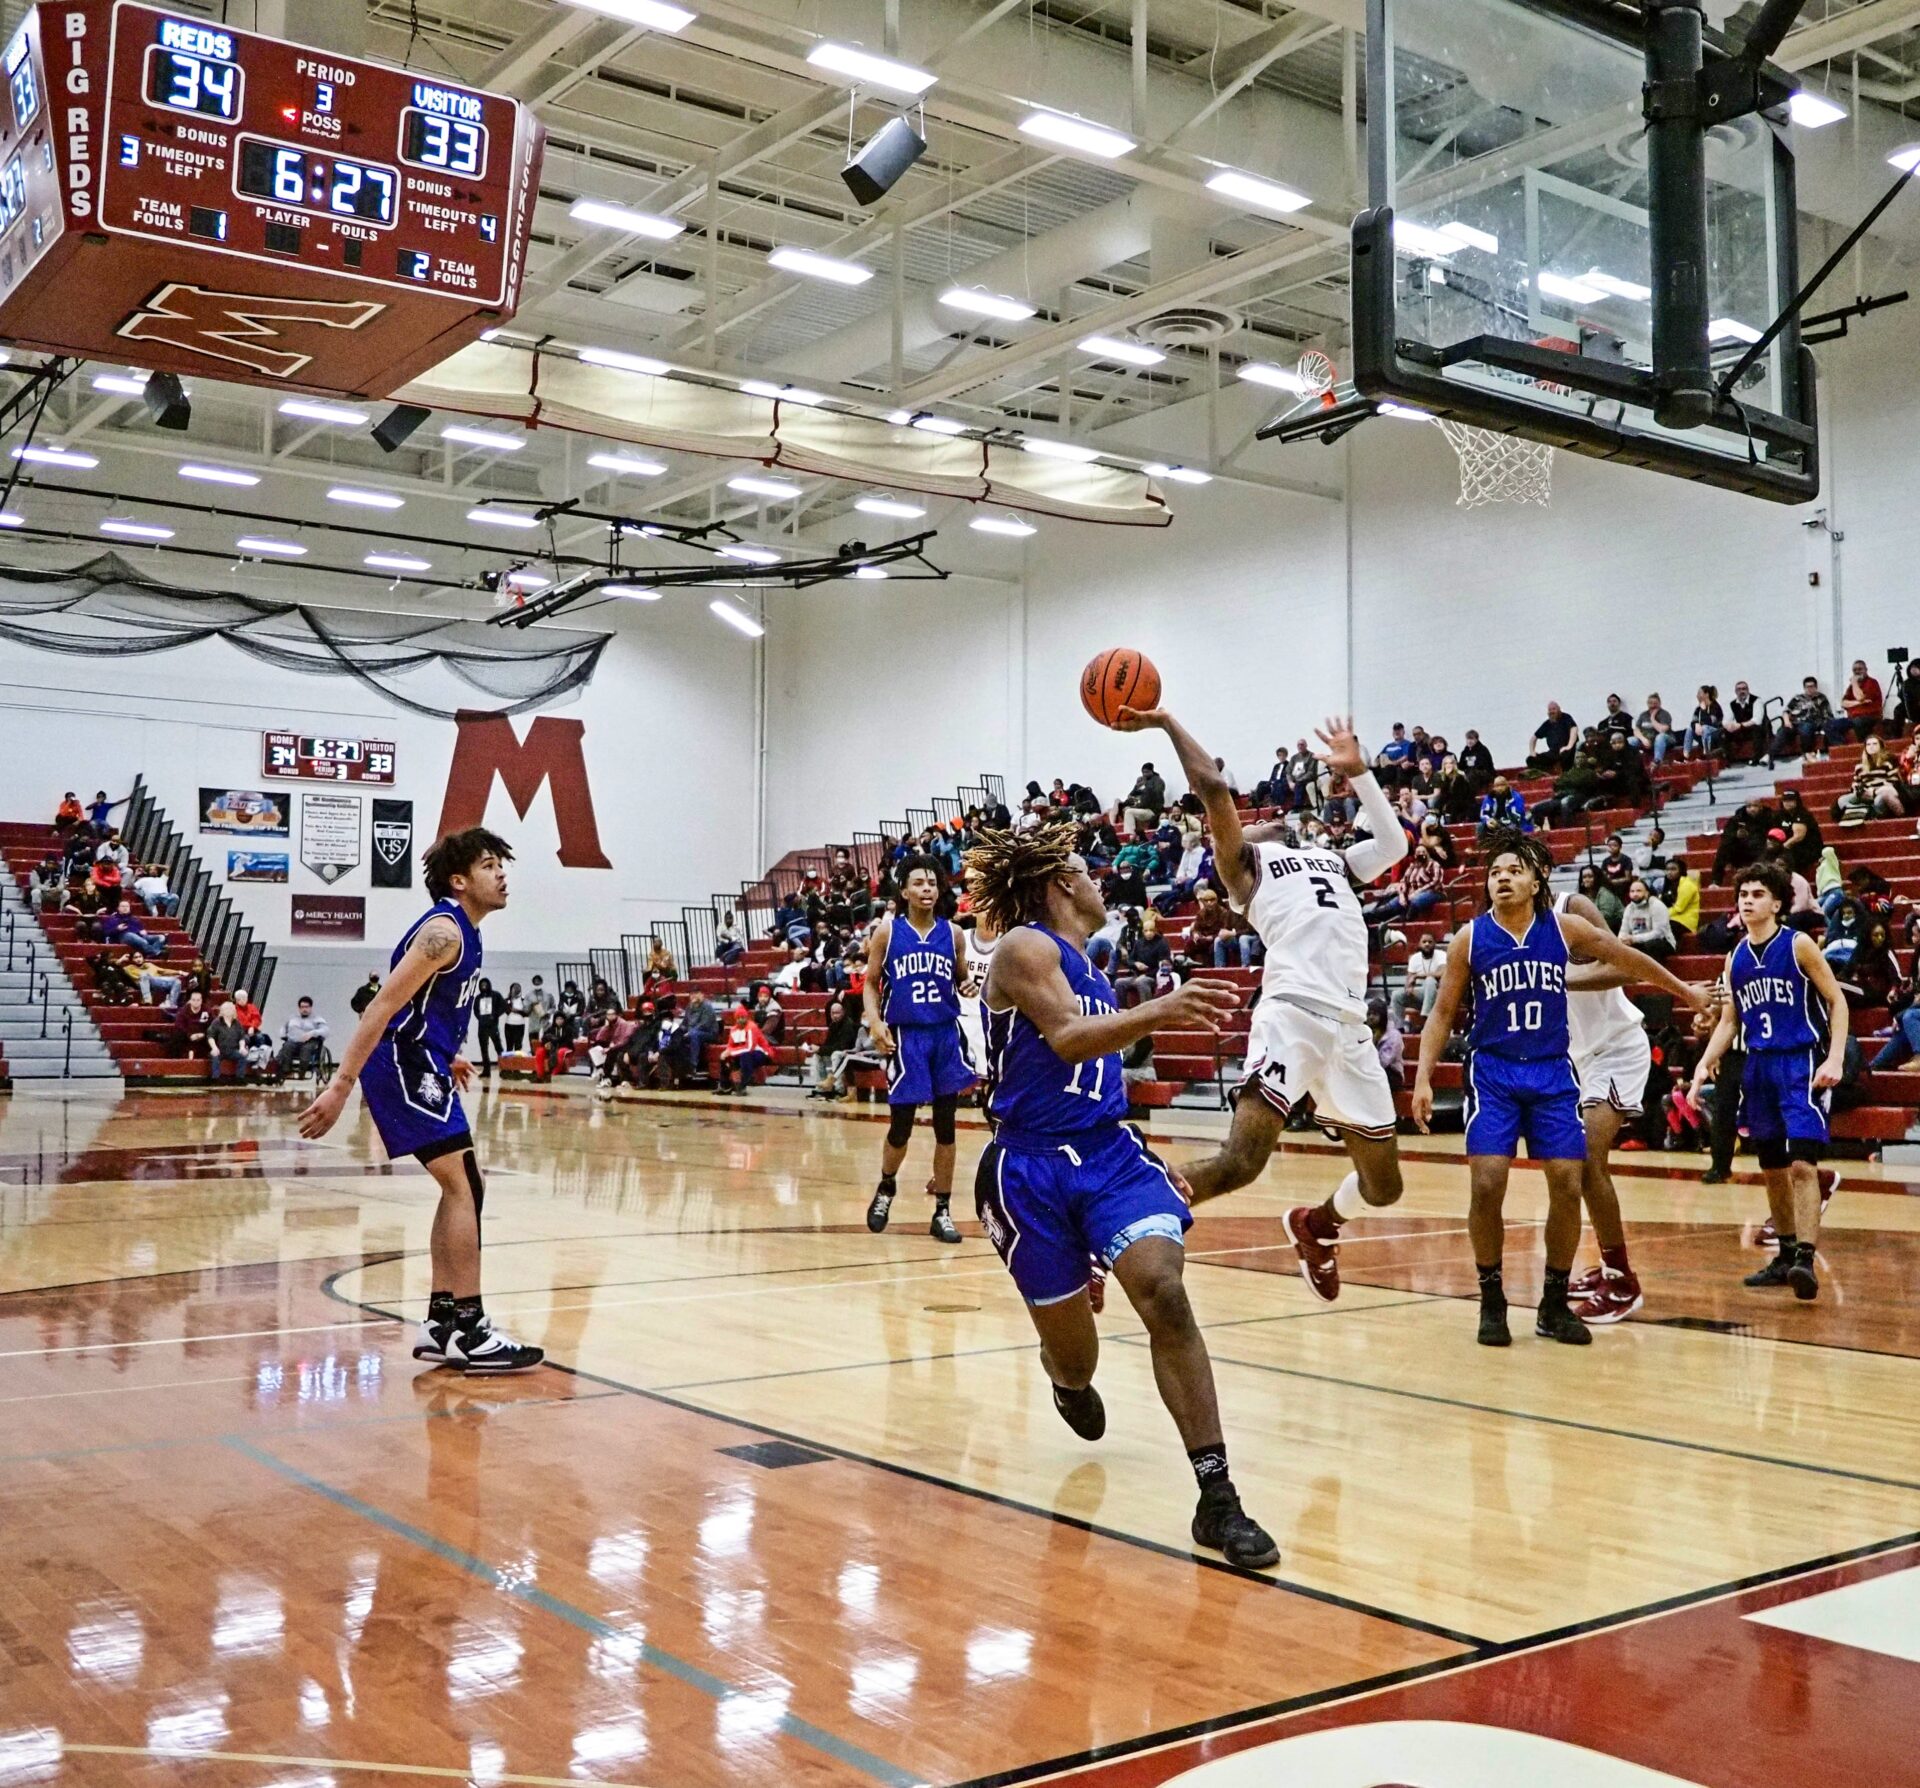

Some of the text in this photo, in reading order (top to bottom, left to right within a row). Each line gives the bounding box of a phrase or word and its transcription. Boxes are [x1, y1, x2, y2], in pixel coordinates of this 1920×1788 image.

[162, 21, 232, 60] REDS
[296, 58, 356, 86] PERIOD
[168, 54, 234, 117] 34
[316, 84, 333, 112] 3
[66, 13, 91, 217] BIG REDS
[414, 84, 482, 121] VISITOR
[302, 110, 342, 132] POSS
[176, 125, 228, 148] BONUS
[421, 115, 479, 173] 33
[121, 136, 140, 166] 3
[145, 142, 226, 170] TIMEOUTS
[165, 161, 204, 179] LEFT
[274, 150, 392, 221] 6:27
[407, 177, 452, 197] BONUS
[139, 197, 181, 217] TEAM
[407, 200, 477, 225] TIMEOUTS
[506, 117, 537, 309] MUSKEGON
[133, 210, 184, 231] FOULS
[218, 213, 227, 239] 1
[256, 206, 378, 242] PLAYER FOULS
[424, 218, 458, 234] LEFT
[481, 217, 497, 242] 4
[413, 253, 430, 279] 2
[439, 258, 475, 276] TEAM
[433, 271, 477, 289] FOULS
[116, 283, 387, 378] M
[270, 735, 294, 745] HOME
[313, 739, 360, 760] 6:27
[364, 742, 395, 753] VISITOR
[271, 746, 296, 766] 34
[369, 753, 393, 773] 33
[336, 764, 347, 780] 3
[434, 708, 614, 869] M
[382, 838, 402, 854] HS
[1268, 857, 1347, 879] BIG REDS
[1310, 877, 1340, 909] 2
[305, 911, 362, 920] MERCY HEALTH
[893, 951, 952, 980] WOLVES
[912, 980, 941, 1004] 22
[1481, 960, 1566, 1001] WOLVES
[1507, 1001, 1543, 1033] 10
[1759, 1012, 1773, 1039] 3
[1063, 1057, 1105, 1102] 11
[1264, 1061, 1288, 1085] M
